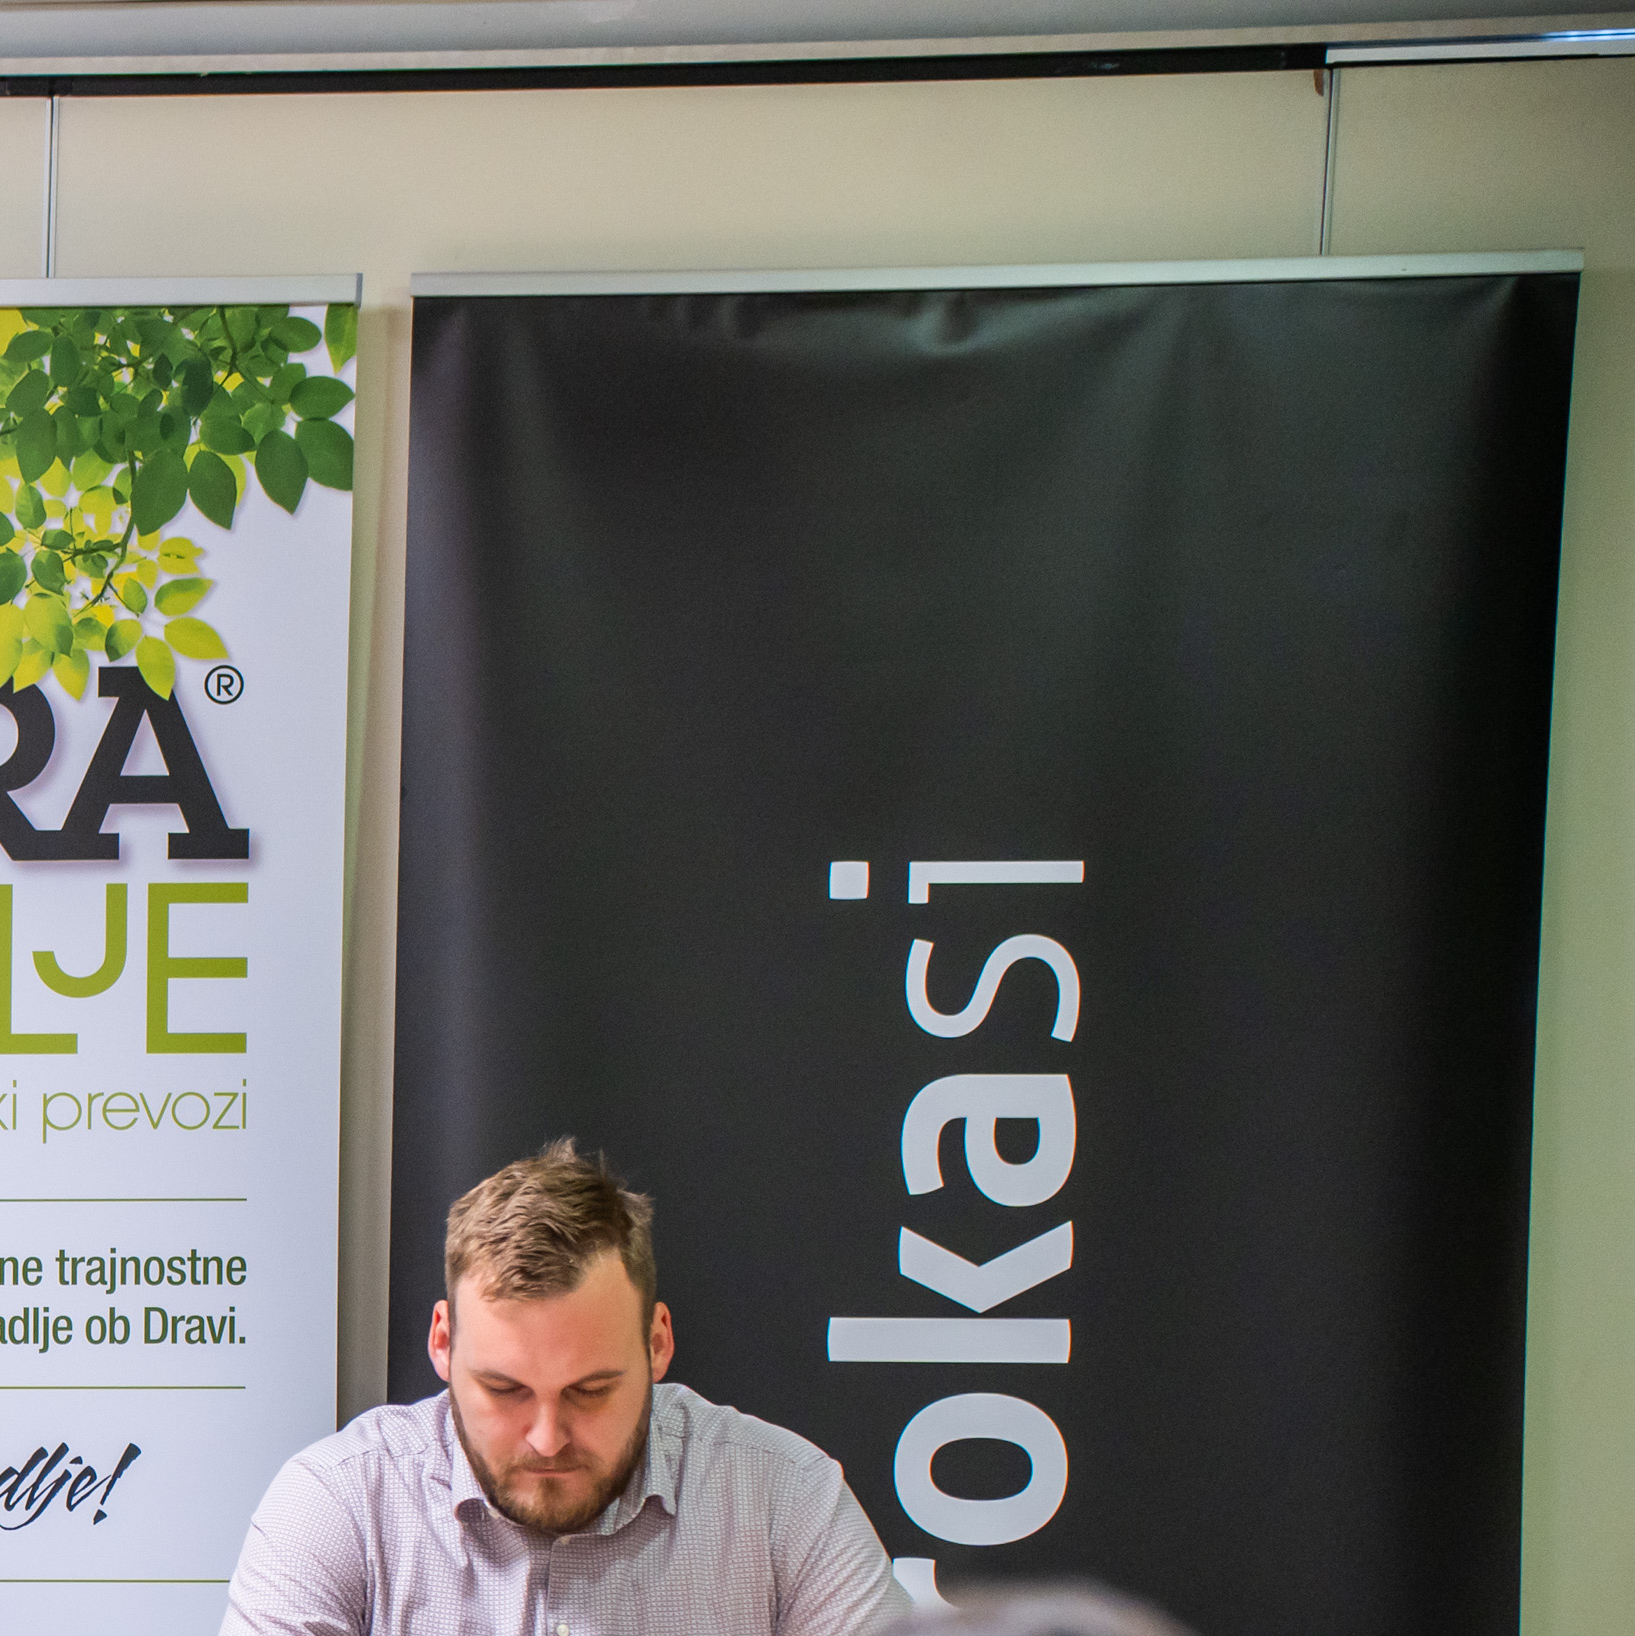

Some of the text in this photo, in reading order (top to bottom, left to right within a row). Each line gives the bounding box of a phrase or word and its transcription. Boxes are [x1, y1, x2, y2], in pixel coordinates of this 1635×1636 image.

[41, 1078, 248, 1144] prevozi
[55, 1247, 248, 1295] trajnostne
[85, 1307, 131, 1345] ob
[143, 1305, 247, 1345] Dravi.
